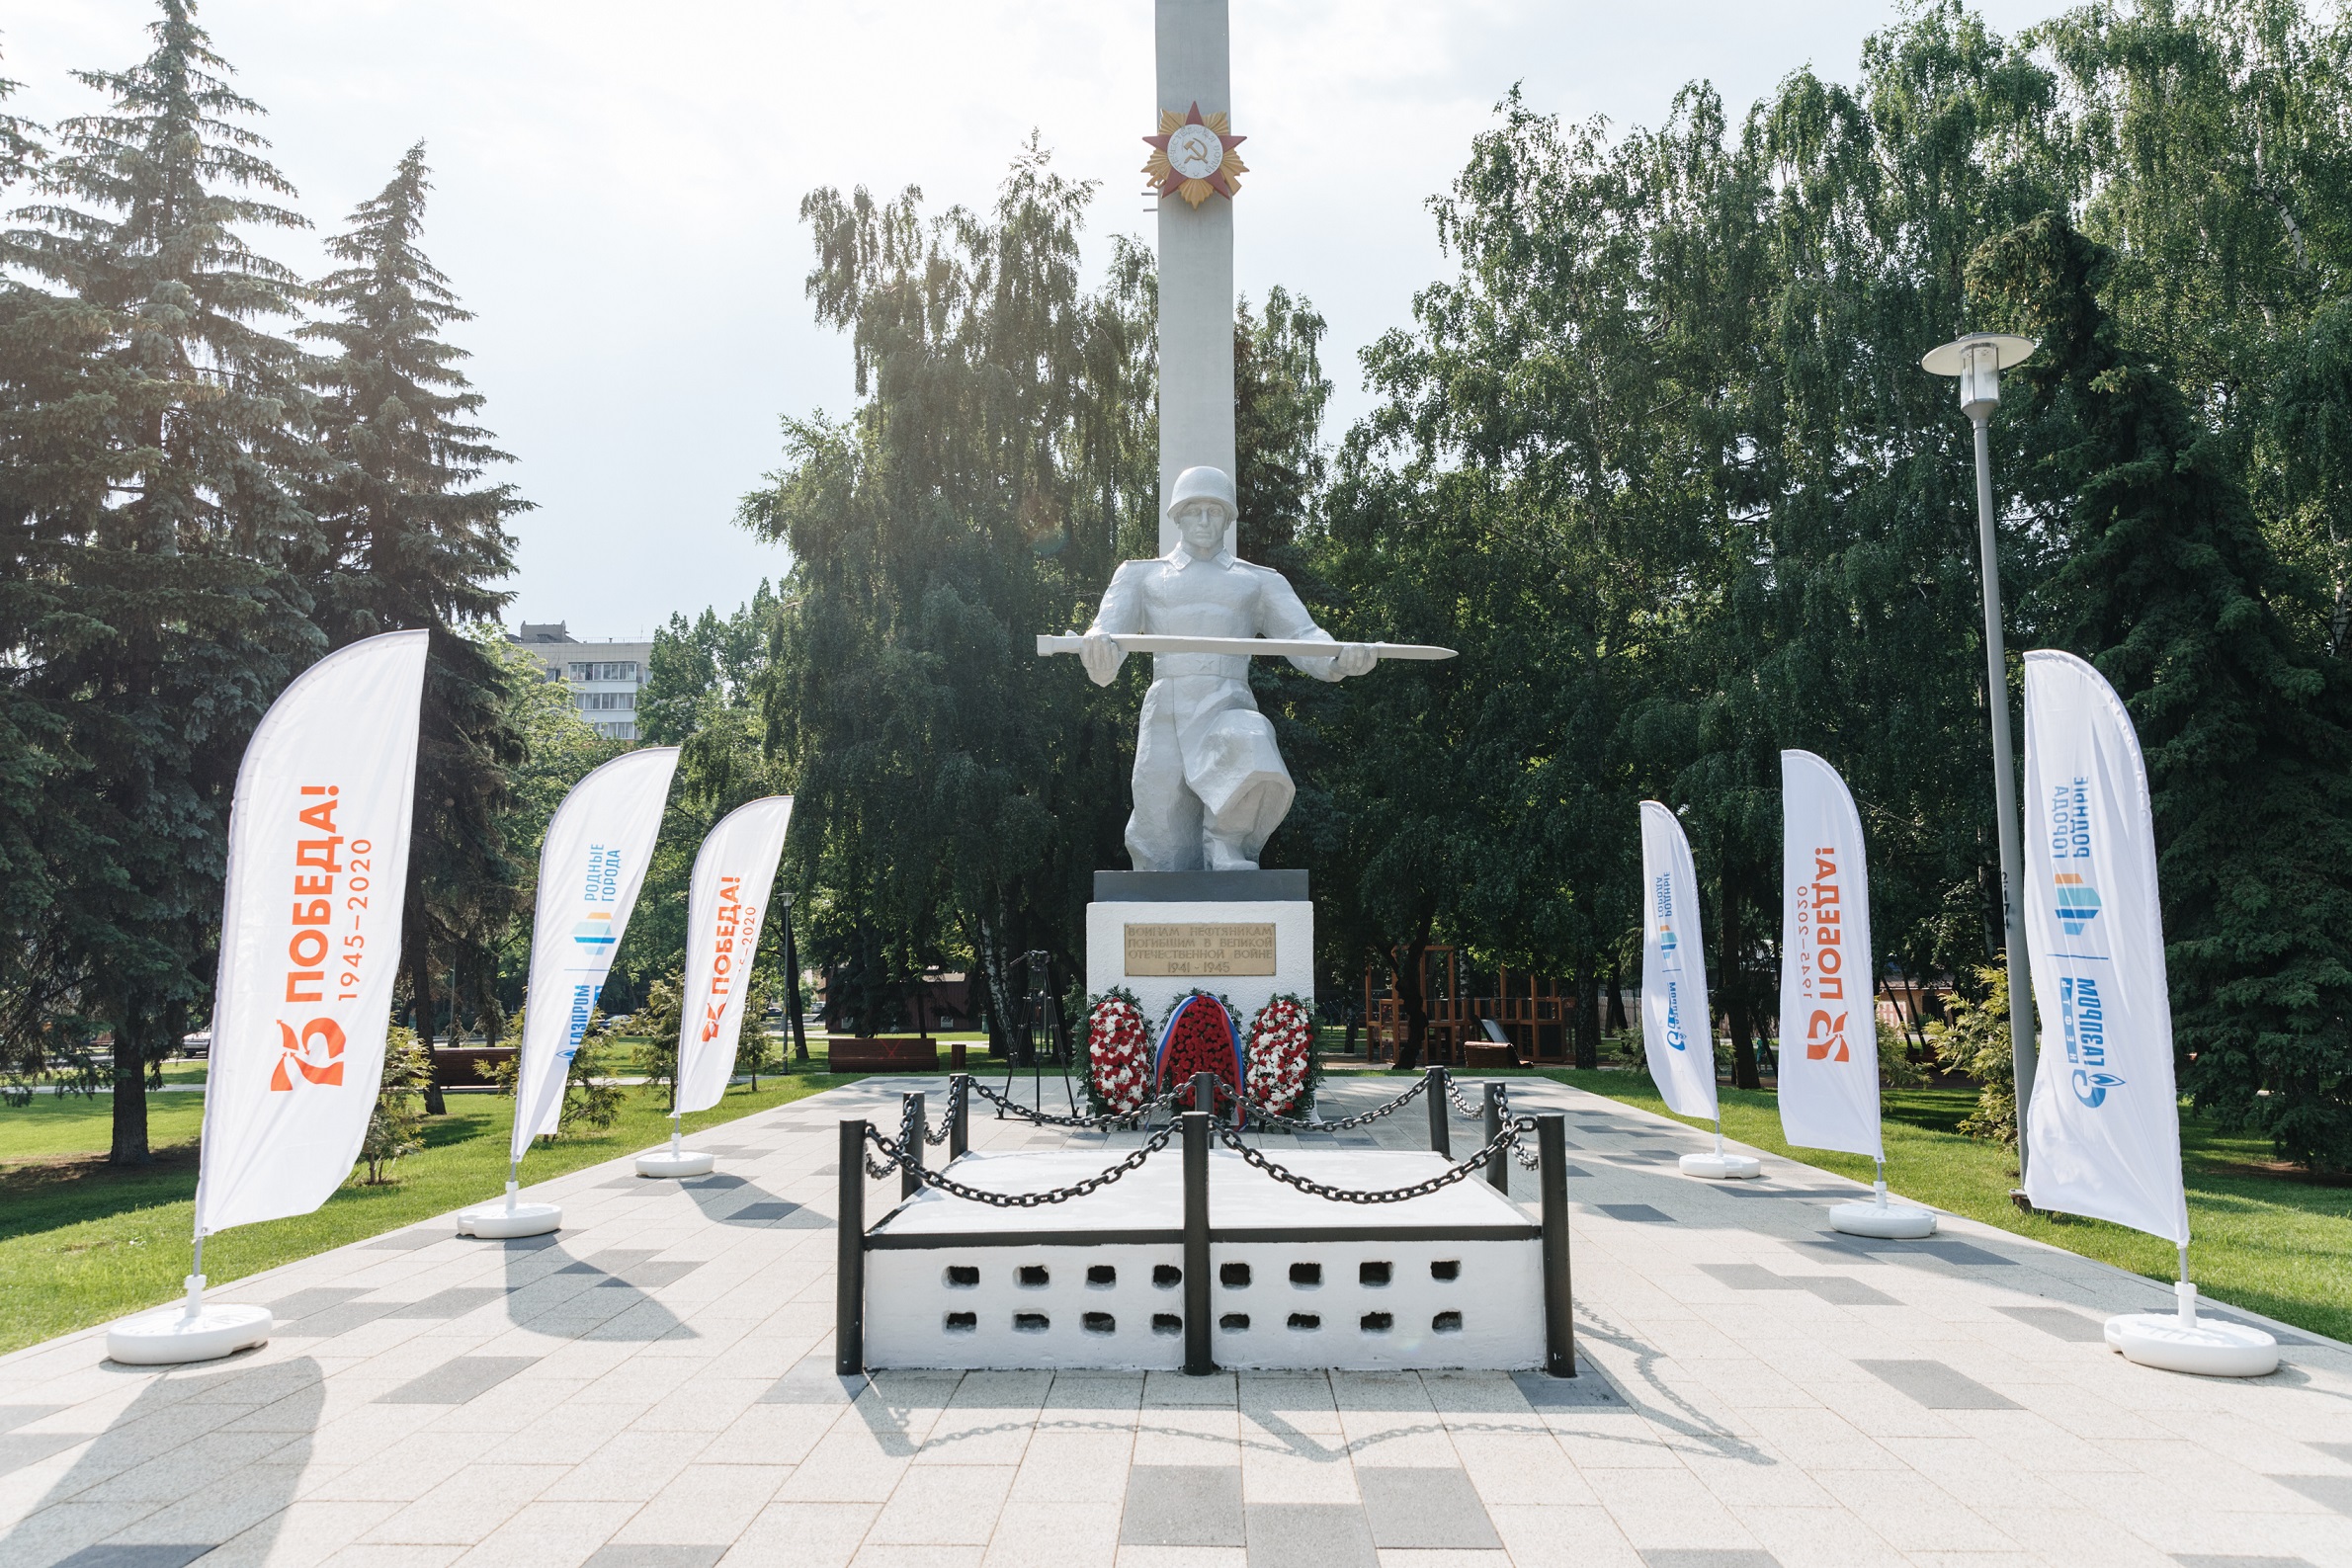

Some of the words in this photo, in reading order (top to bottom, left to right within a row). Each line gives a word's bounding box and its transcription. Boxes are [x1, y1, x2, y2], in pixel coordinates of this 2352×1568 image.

[286, 785, 344, 1003] ПОБЕДА!
[585, 844, 604, 901] РОДНЫЕ
[602, 850, 622, 901] ГОРОДА
[712, 876, 741, 995] ПОБЕДА!
[1128, 927, 1180, 937] ВОИНАМ
[1190, 927, 1273, 937] НЕФТЯНИКАМ
[1129, 939, 1196, 948] ПОГИБШИМ
[1204, 939, 1212, 948] В
[1220, 937, 1273, 948] ВЕЛИКОЙ
[1129, 949, 1225, 959] ОТЕЧЕСТВЕННОЙ
[1234, 949, 1273, 959] ВОЙНЕ
[1167, 961, 1191, 973] 1941
[1204, 961, 1230, 973] 1945
[570, 985, 591, 1045] ГАЗПРОМ
